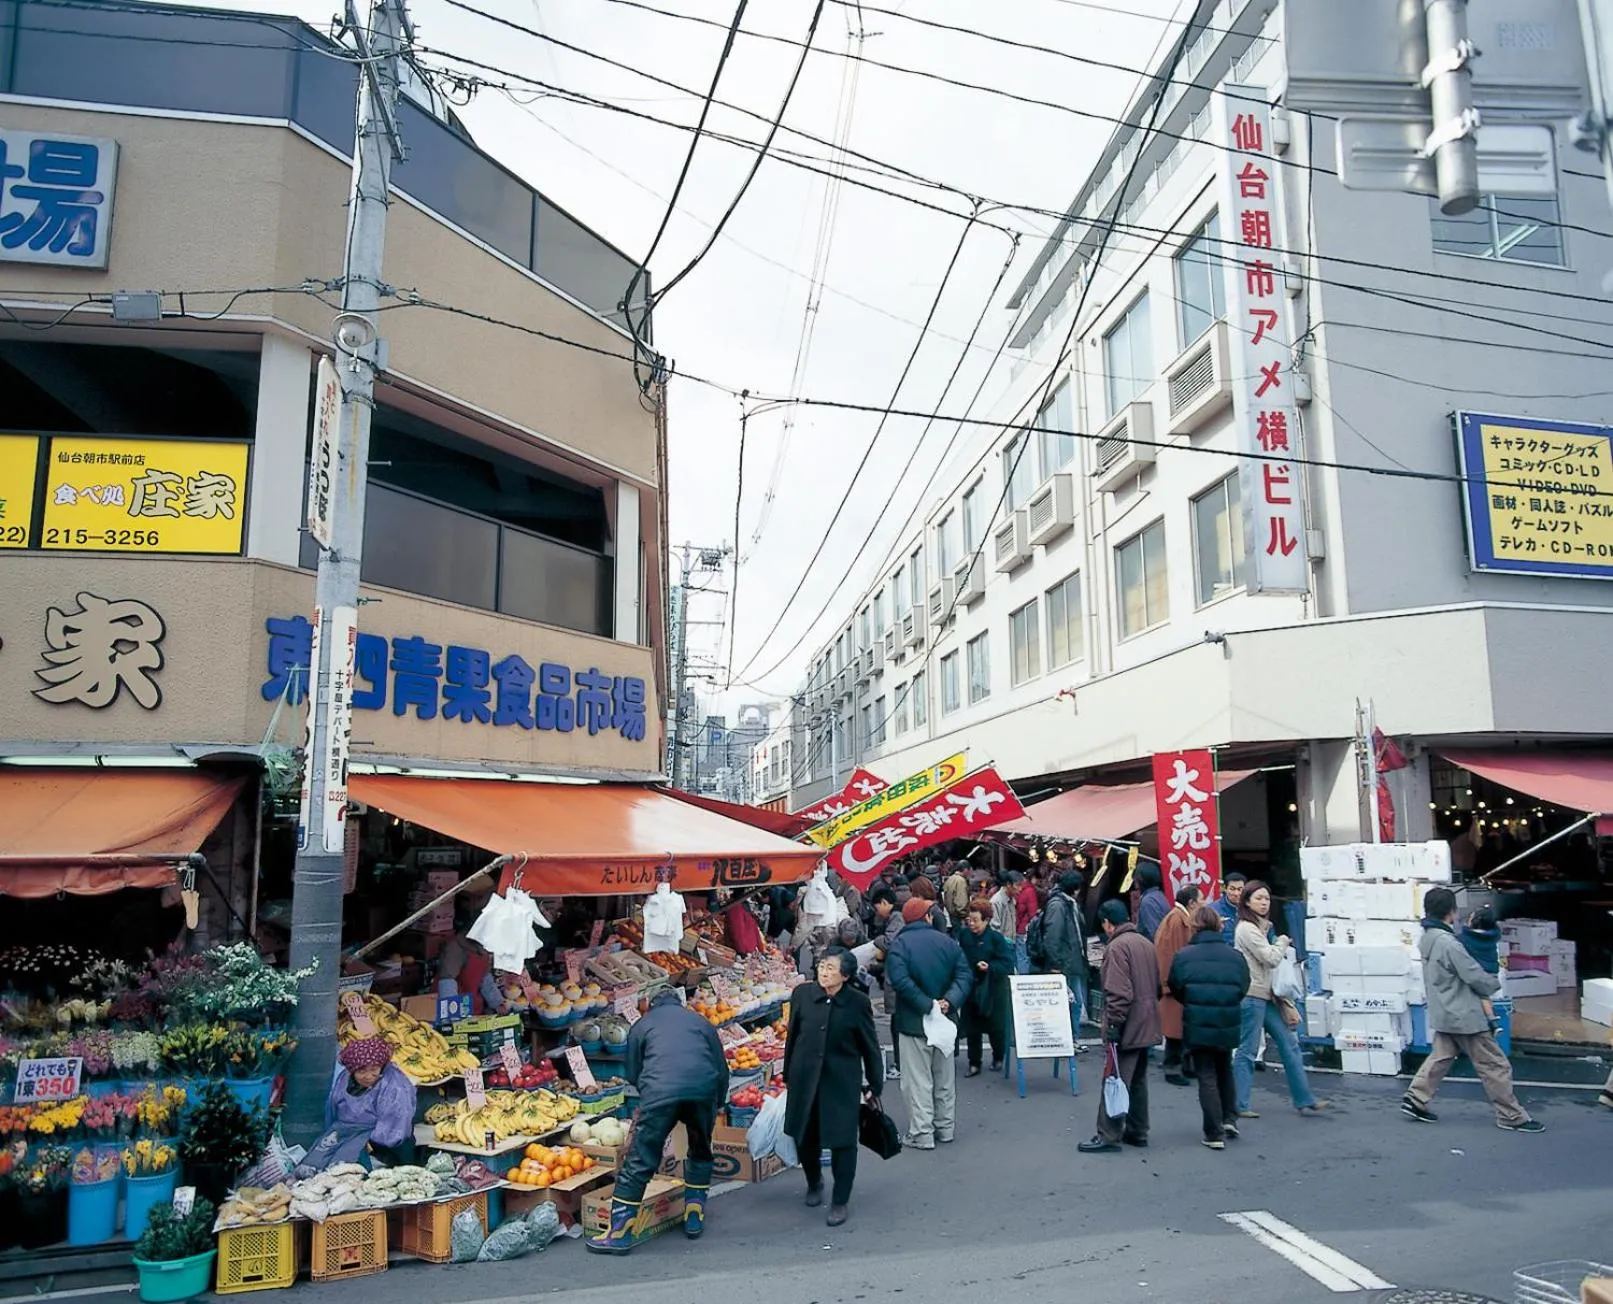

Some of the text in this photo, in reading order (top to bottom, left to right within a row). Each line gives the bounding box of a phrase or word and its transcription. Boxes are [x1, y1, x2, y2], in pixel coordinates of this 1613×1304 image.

[1231, 113, 1298, 558] 仙台朝市アメ横ビル
[57, 451, 146, 466] 仙台朝市駅前店
[127, 468, 236, 520] 庄家
[46, 527, 160, 546] 215-3256
[1511, 516, 1584, 535] ゲームソフト
[262, 615, 646, 742] 東四青果食品市場
